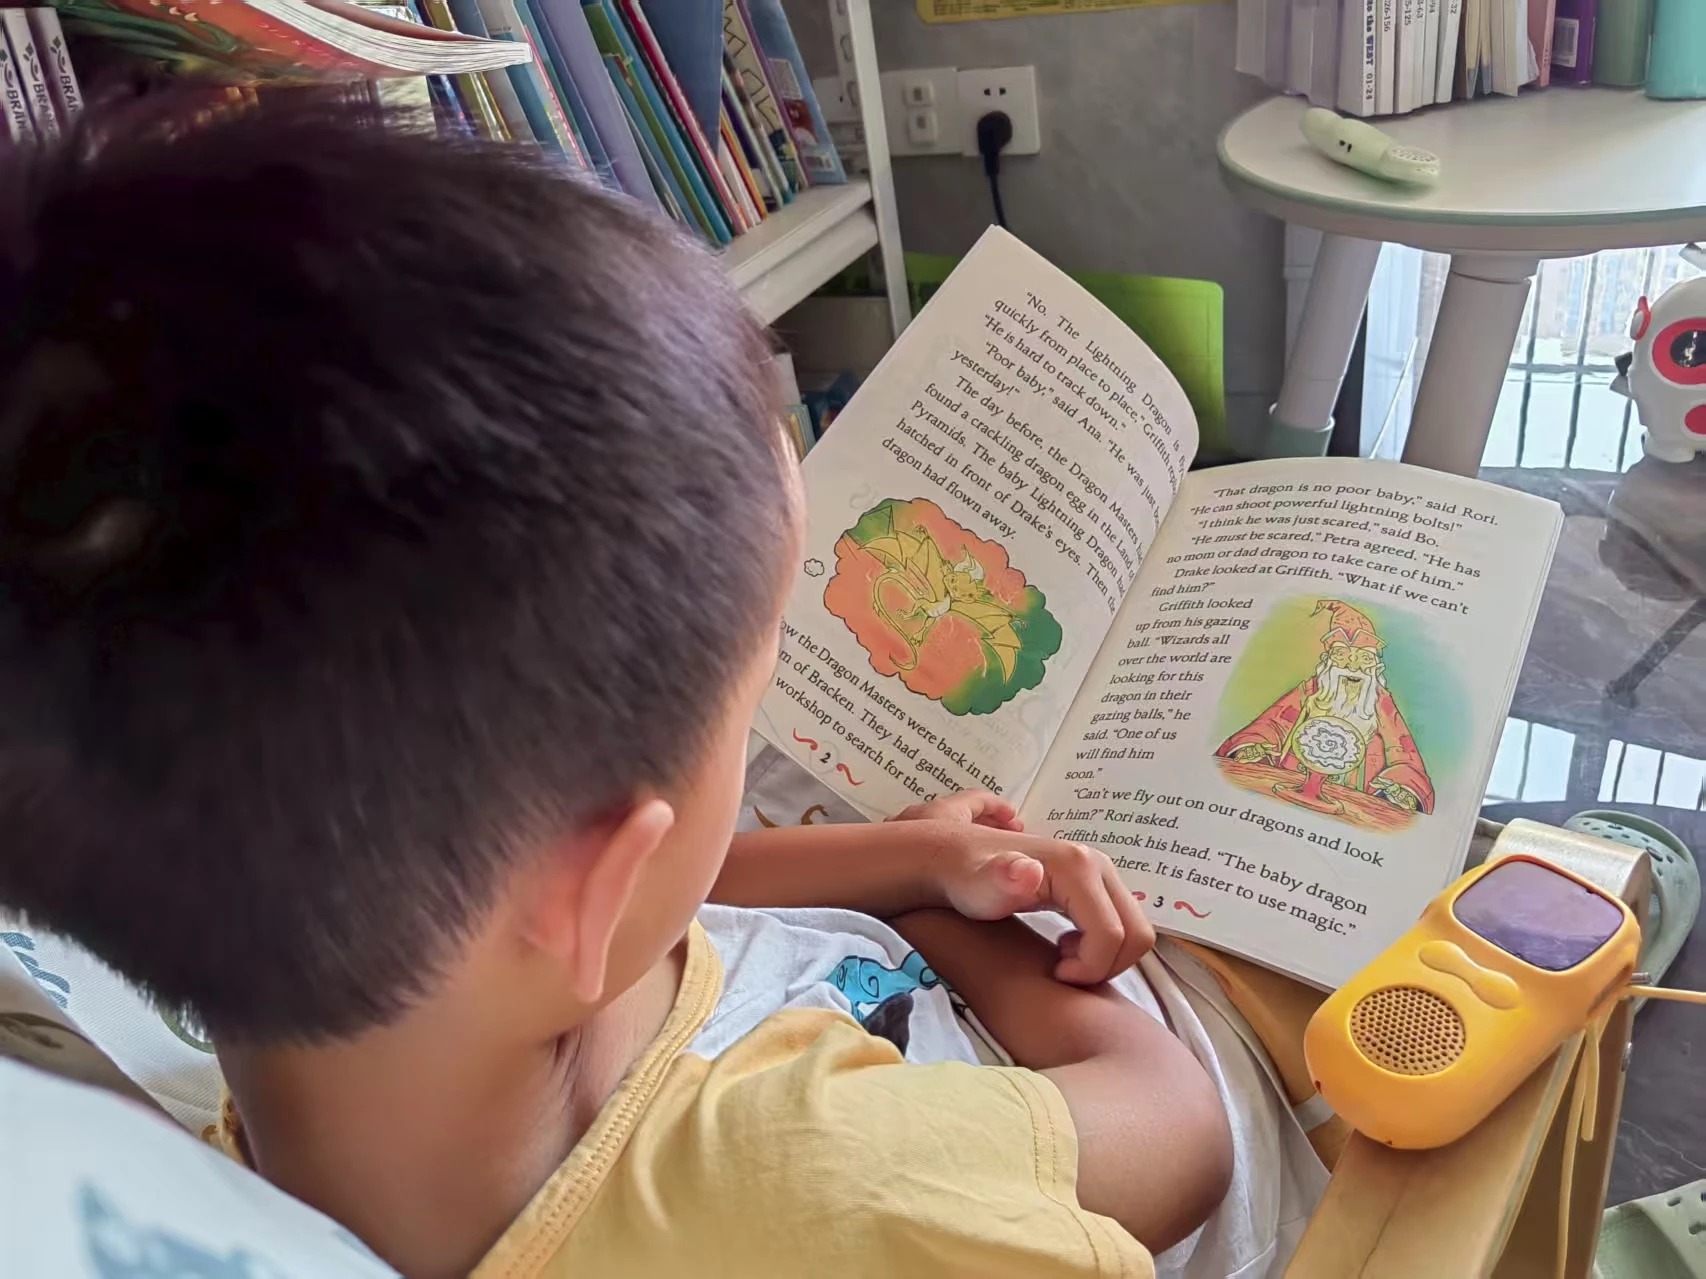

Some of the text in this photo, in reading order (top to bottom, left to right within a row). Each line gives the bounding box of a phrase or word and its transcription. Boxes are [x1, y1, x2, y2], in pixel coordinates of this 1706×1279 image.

[1366, 15, 1374, 33] the
[1404, 0, 1412, 26] 5-125
[1366, 35, 1374, 66] WEST
[1365, 73, 1374, 101] 01-24
[950, 350, 1020, 396] yesterday!"
[985, 314, 1126, 430] "He hard track down."
[995, 300, 1145, 423] quickly from place place,"
[1027, 292, 1171, 435] "No. The Lightning Dragon
[956, 376, 1108, 504] The day before, the Dragon
[986, 342, 1156, 508] "Poor baby," said Ana. "He was just
[925, 383, 1116, 543] found crackling dragon egg the
[882, 438, 1016, 539] dragon had flown away.
[910, 400, 1118, 578] Pyramids. The baby Lightning Dragon
[1214, 485, 1497, 525] "That dragon poor baby," said Rori.
[896, 418, 1108, 596] hatched front Drake's eyes. Then
[1191, 499, 1462, 532] "He can shoot powerful lightning bolts!"
[1209, 517, 1244, 527] think
[1292, 515, 1320, 526] just
[1322, 519, 1380, 532] scared,"
[1380, 528, 1412, 540] said
[1414, 532, 1438, 547] Bo.
[1183, 547, 1464, 591] mom dad dragon take care him."
[1192, 531, 1480, 577] "He must scared," Petra agreed. "He has
[1152, 582, 1215, 597] find him?"
[1159, 598, 1254, 611] Griffith looked
[1174, 564, 1469, 615] Drake looked Griffith. "What can't
[1127, 634, 1230, 648] ball. "Wizards all
[1152, 617, 1250, 630] from his gazing
[1118, 652, 1232, 666] over the world are
[1110, 671, 1204, 685] looking for this
[798, 635, 818, 653] the
[817, 647, 860, 686] Dragon
[859, 680, 906, 720] Masters
[908, 717, 937, 744] were
[937, 738, 967, 768] back
[981, 775, 1002, 795] the
[807, 670, 920, 760] Bracken. They had
[1101, 690, 1192, 705] dragon their
[1083, 728, 1143, 740] said. "One
[1091, 708, 1173, 724] gazing balls,"
[776, 677, 924, 796] workshop search for the
[1077, 748, 1154, 759] will find him
[820, 752, 831, 764] 2
[1065, 768, 1103, 779] soon."
[1047, 809, 1178, 829] for Rori asked.
[1134, 789, 1384, 867] fly out our dragons and look
[1100, 832, 1367, 915] shook his head. "The baby dragon
[1153, 896, 1164, 908] 3
[1186, 868, 1356, 935] faster use magic."
